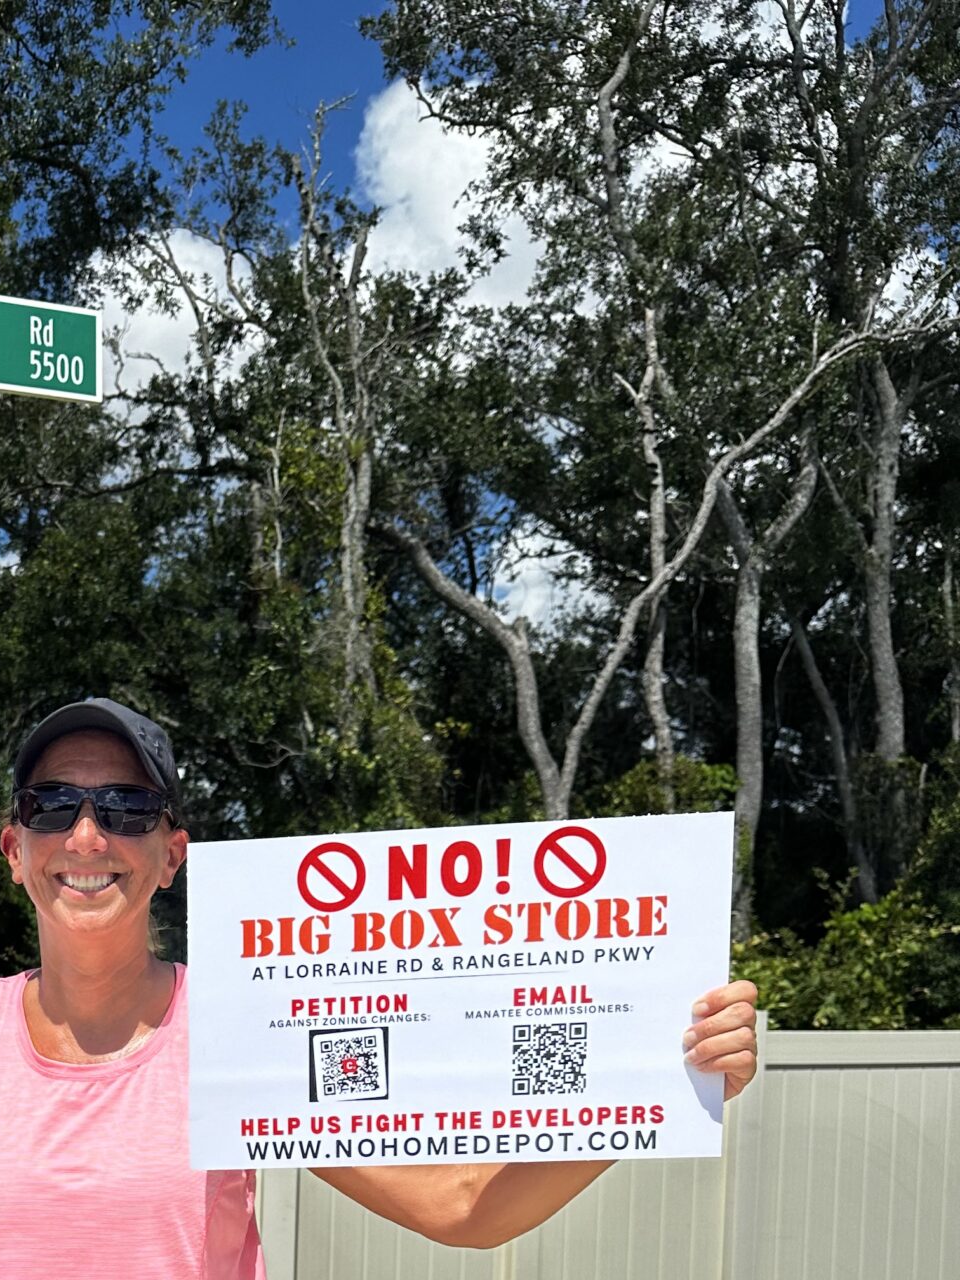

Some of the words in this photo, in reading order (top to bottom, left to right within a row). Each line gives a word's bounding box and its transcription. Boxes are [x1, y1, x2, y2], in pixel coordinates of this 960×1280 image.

[30, 315, 53, 347] Rd
[29, 349, 84, 386] 5500
[388, 839, 511, 901] NO!
[241, 915, 331, 958] BIG
[352, 908, 462, 952] BOX
[484, 896, 667, 945] STORE
[252, 966, 276, 980] AT
[285, 960, 387, 978] LORRAINE
[397, 959, 422, 973] RD
[432, 957, 443, 971] &
[453, 950, 584, 970] RANGELAND
[595, 946, 654, 963] PKWY
[292, 994, 407, 1017] PETITION
[466, 1009, 521, 1018] MANATEE
[527, 1004, 633, 1016] COMMISSIONERS:
[514, 985, 592, 1006] EMAIL
[270, 1019, 317, 1028] AGAINST
[323, 1017, 366, 1025] ZONING
[372, 1013, 431, 1023] CHANGES:
[241, 1118, 300, 1136] HELP
[311, 1116, 341, 1134] US
[352, 1113, 424, 1133] FIGHT
[435, 1111, 481, 1130] THE
[493, 1105, 664, 1128] DEVELOPERS
[247, 1130, 656, 1160] WWW.NOHOMEDEPOT.COM
